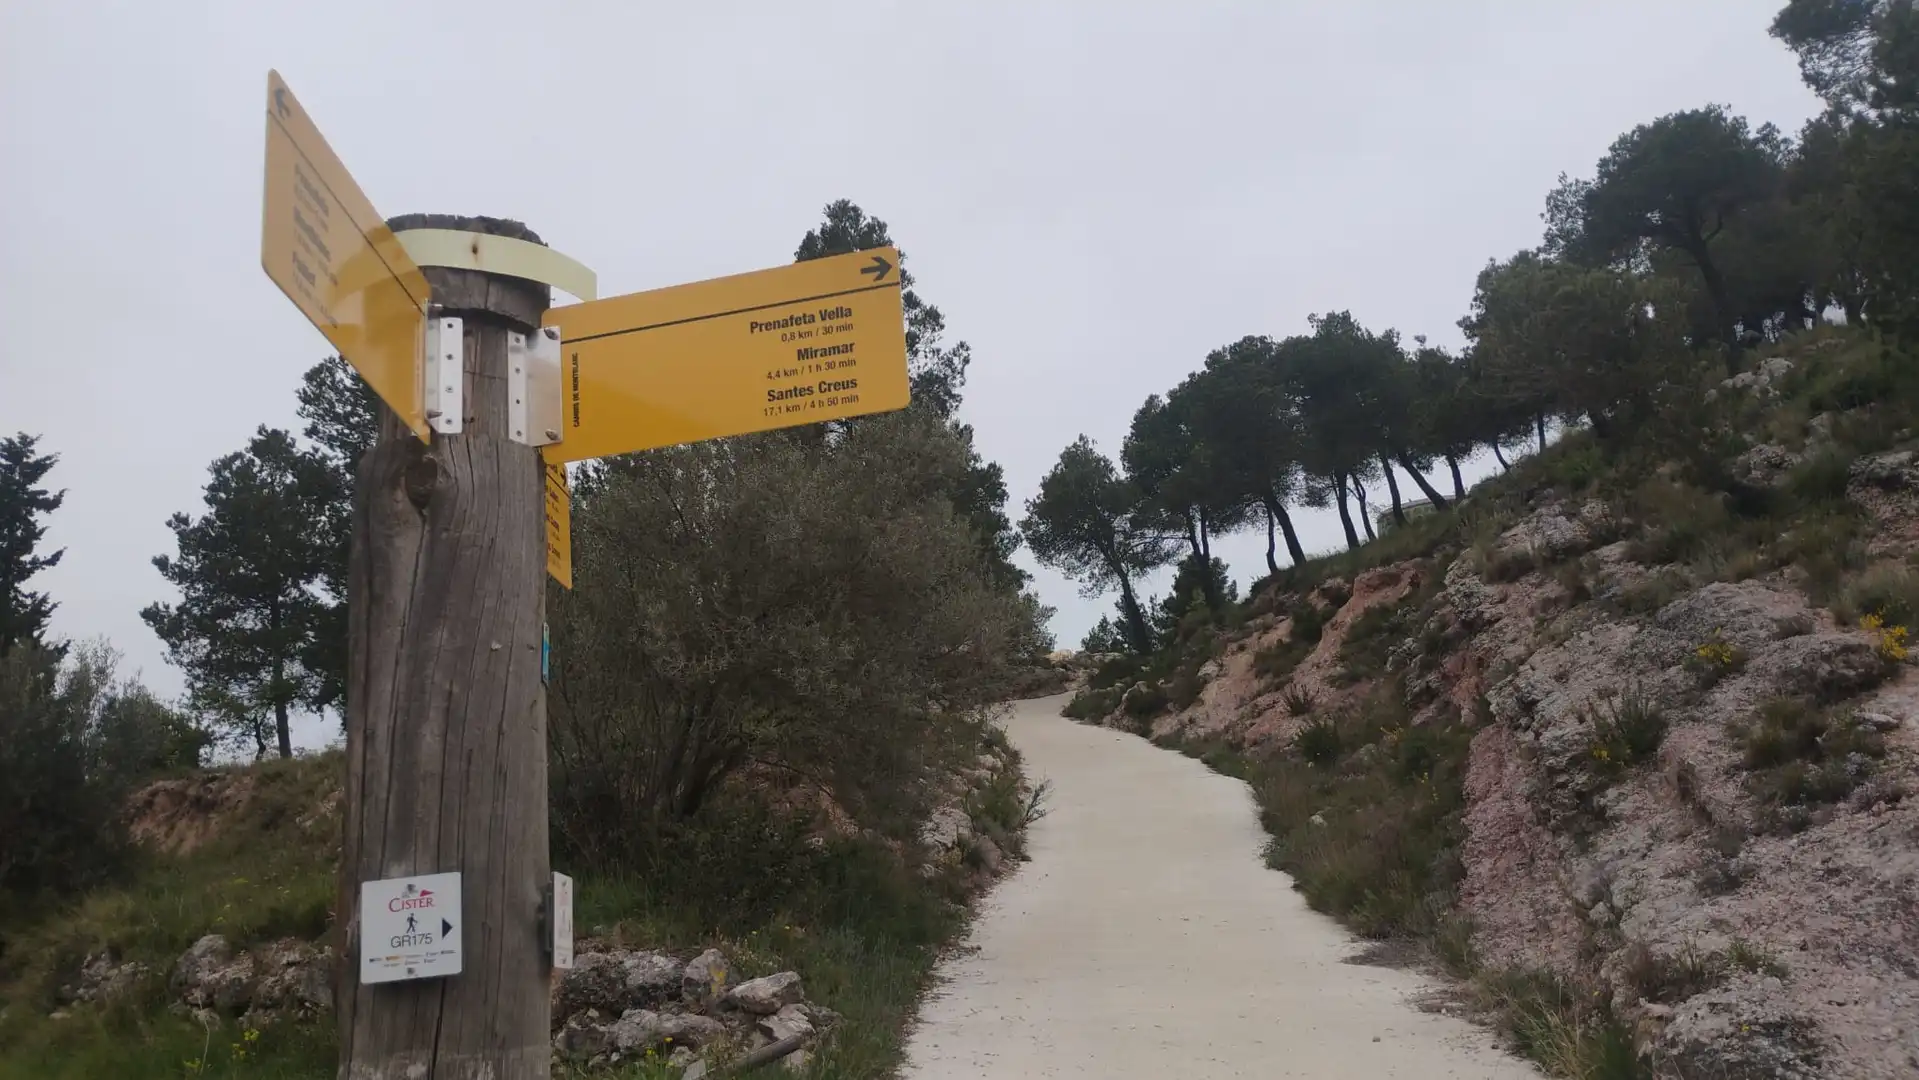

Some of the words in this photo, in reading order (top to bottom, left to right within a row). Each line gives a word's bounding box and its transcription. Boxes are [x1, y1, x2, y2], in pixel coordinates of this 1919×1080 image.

[750, 312, 816, 334] Prenafeta
[819, 306, 852, 321] Vella
[781, 331, 796, 343] 0,8
[798, 330, 813, 340] km
[822, 325, 834, 335] 30
[836, 321, 854, 333] min
[796, 342, 855, 361] Miramar
[766, 370, 781, 380] 4,4
[783, 367, 798, 377] km
[815, 363, 822, 372] h
[825, 361, 836, 371] 30
[838, 358, 857, 368] min
[767, 385, 814, 402] Santes
[818, 378, 858, 394] Creus
[763, 406, 782, 417] 17,1
[785, 404, 801, 413] km
[810, 400, 816, 409] 4
[818, 399, 824, 408] h
[841, 393, 859, 404] min
[390, 932, 433, 949] GR175
